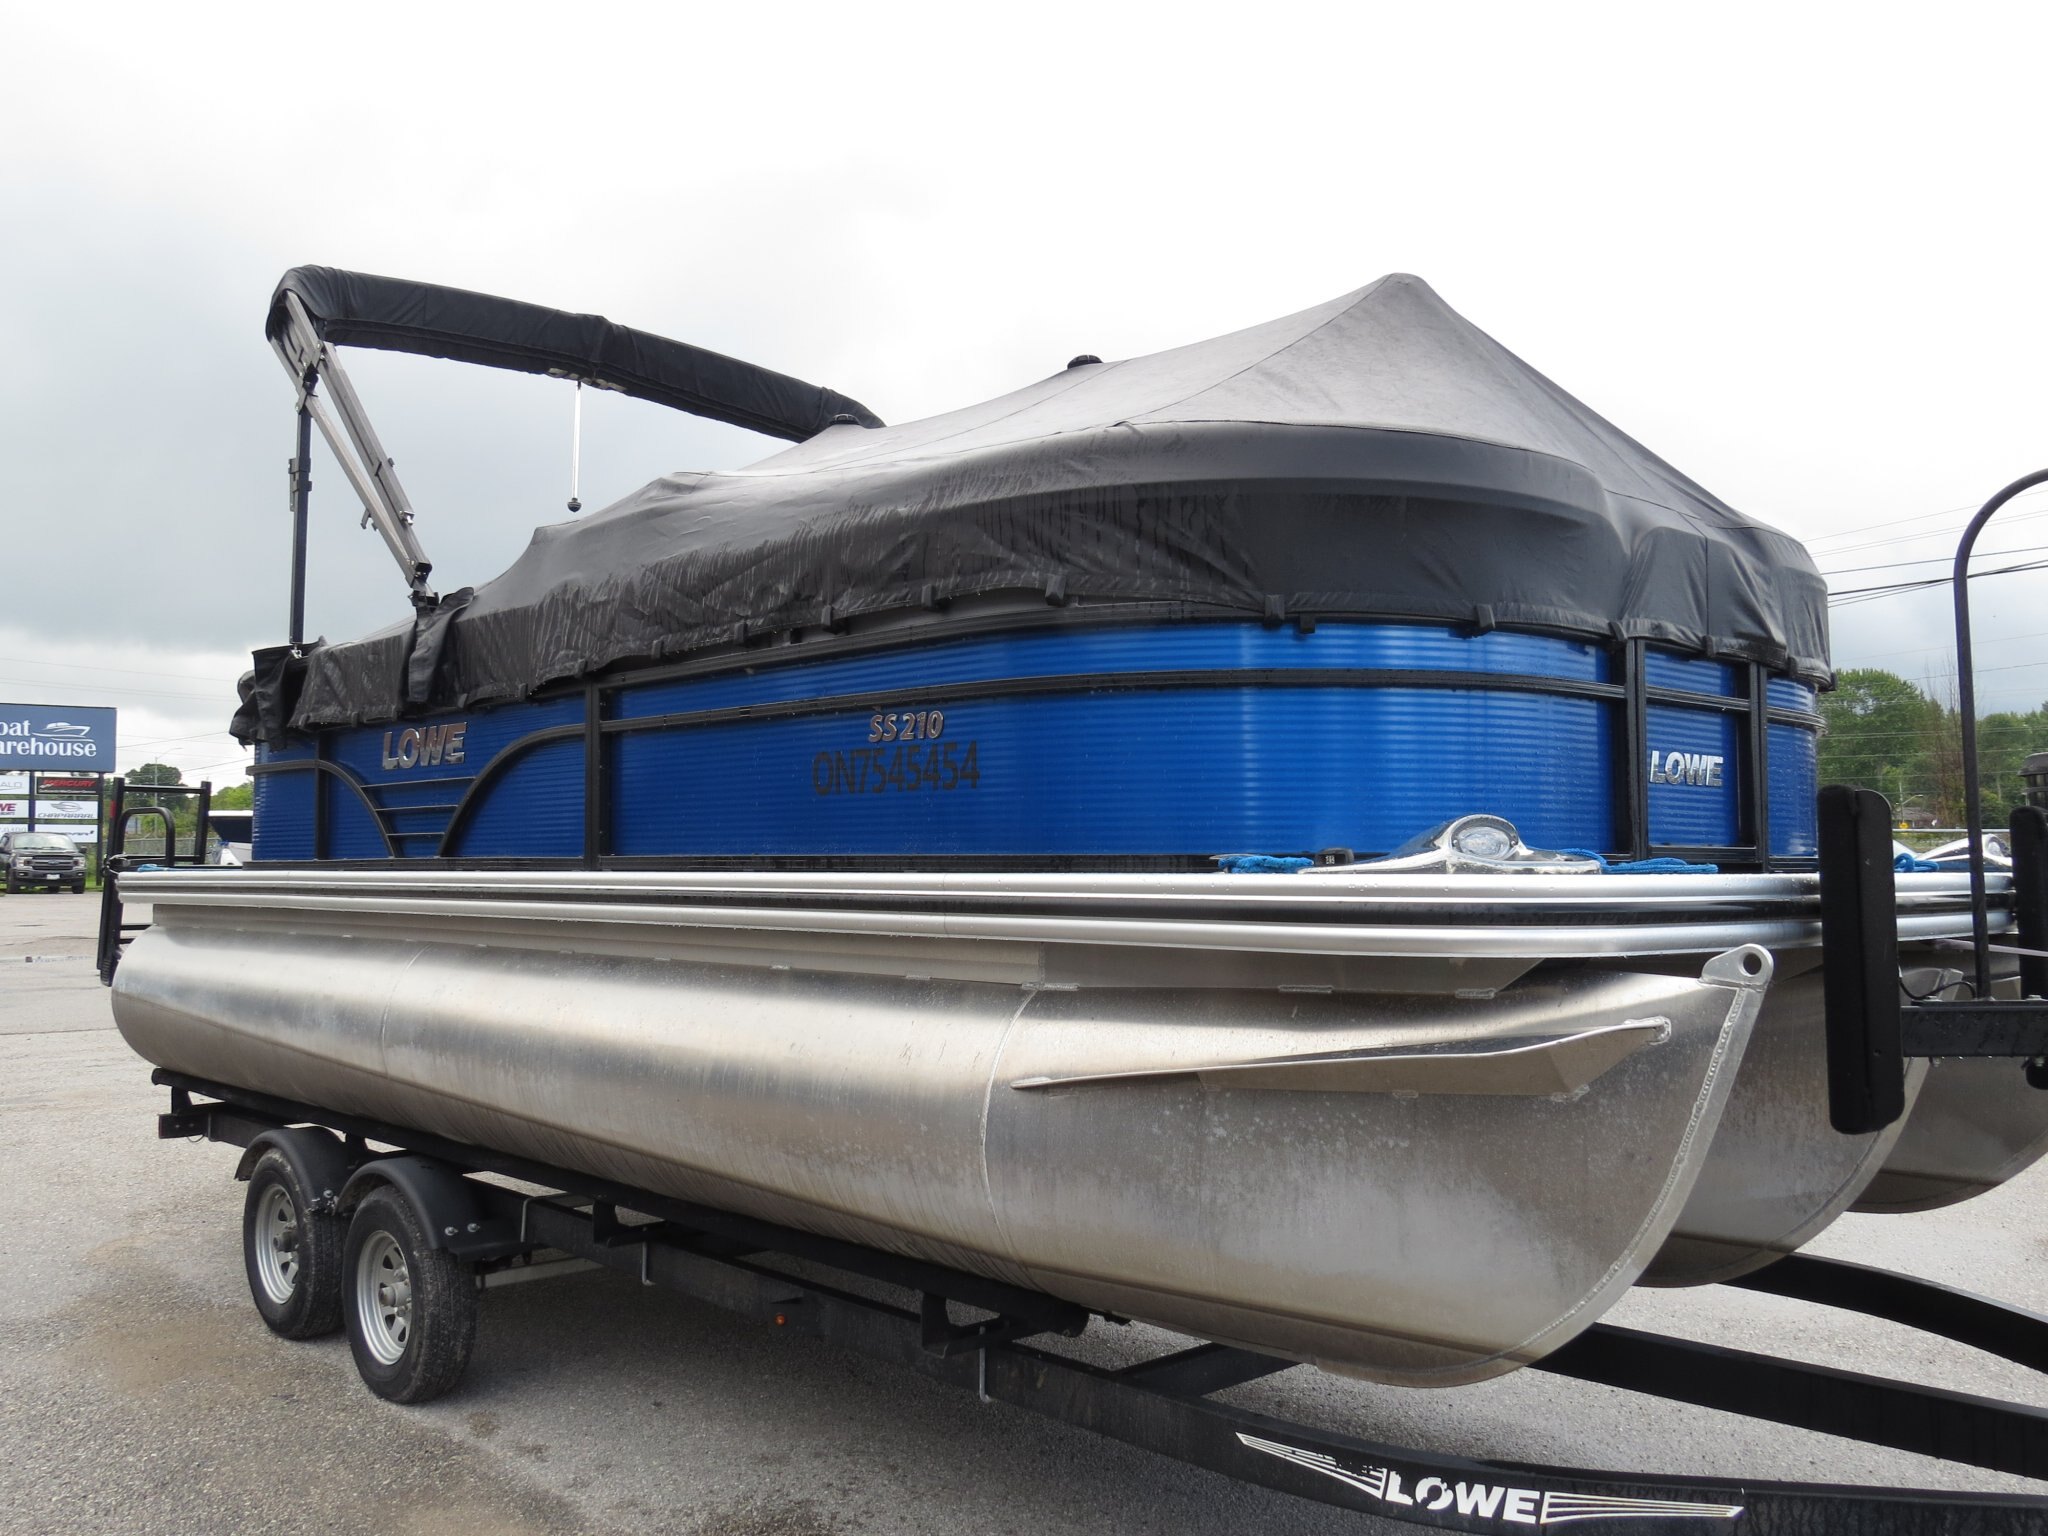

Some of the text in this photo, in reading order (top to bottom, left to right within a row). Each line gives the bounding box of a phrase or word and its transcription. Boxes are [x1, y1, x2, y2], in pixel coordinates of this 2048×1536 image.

[382, 722, 467, 770] LOWE
[868, 710, 944, 742] SS 210
[812, 740, 980, 795] ON7545454
[1649, 750, 1724, 786] LOWE
[1385, 1471, 1541, 1524] LOWE
